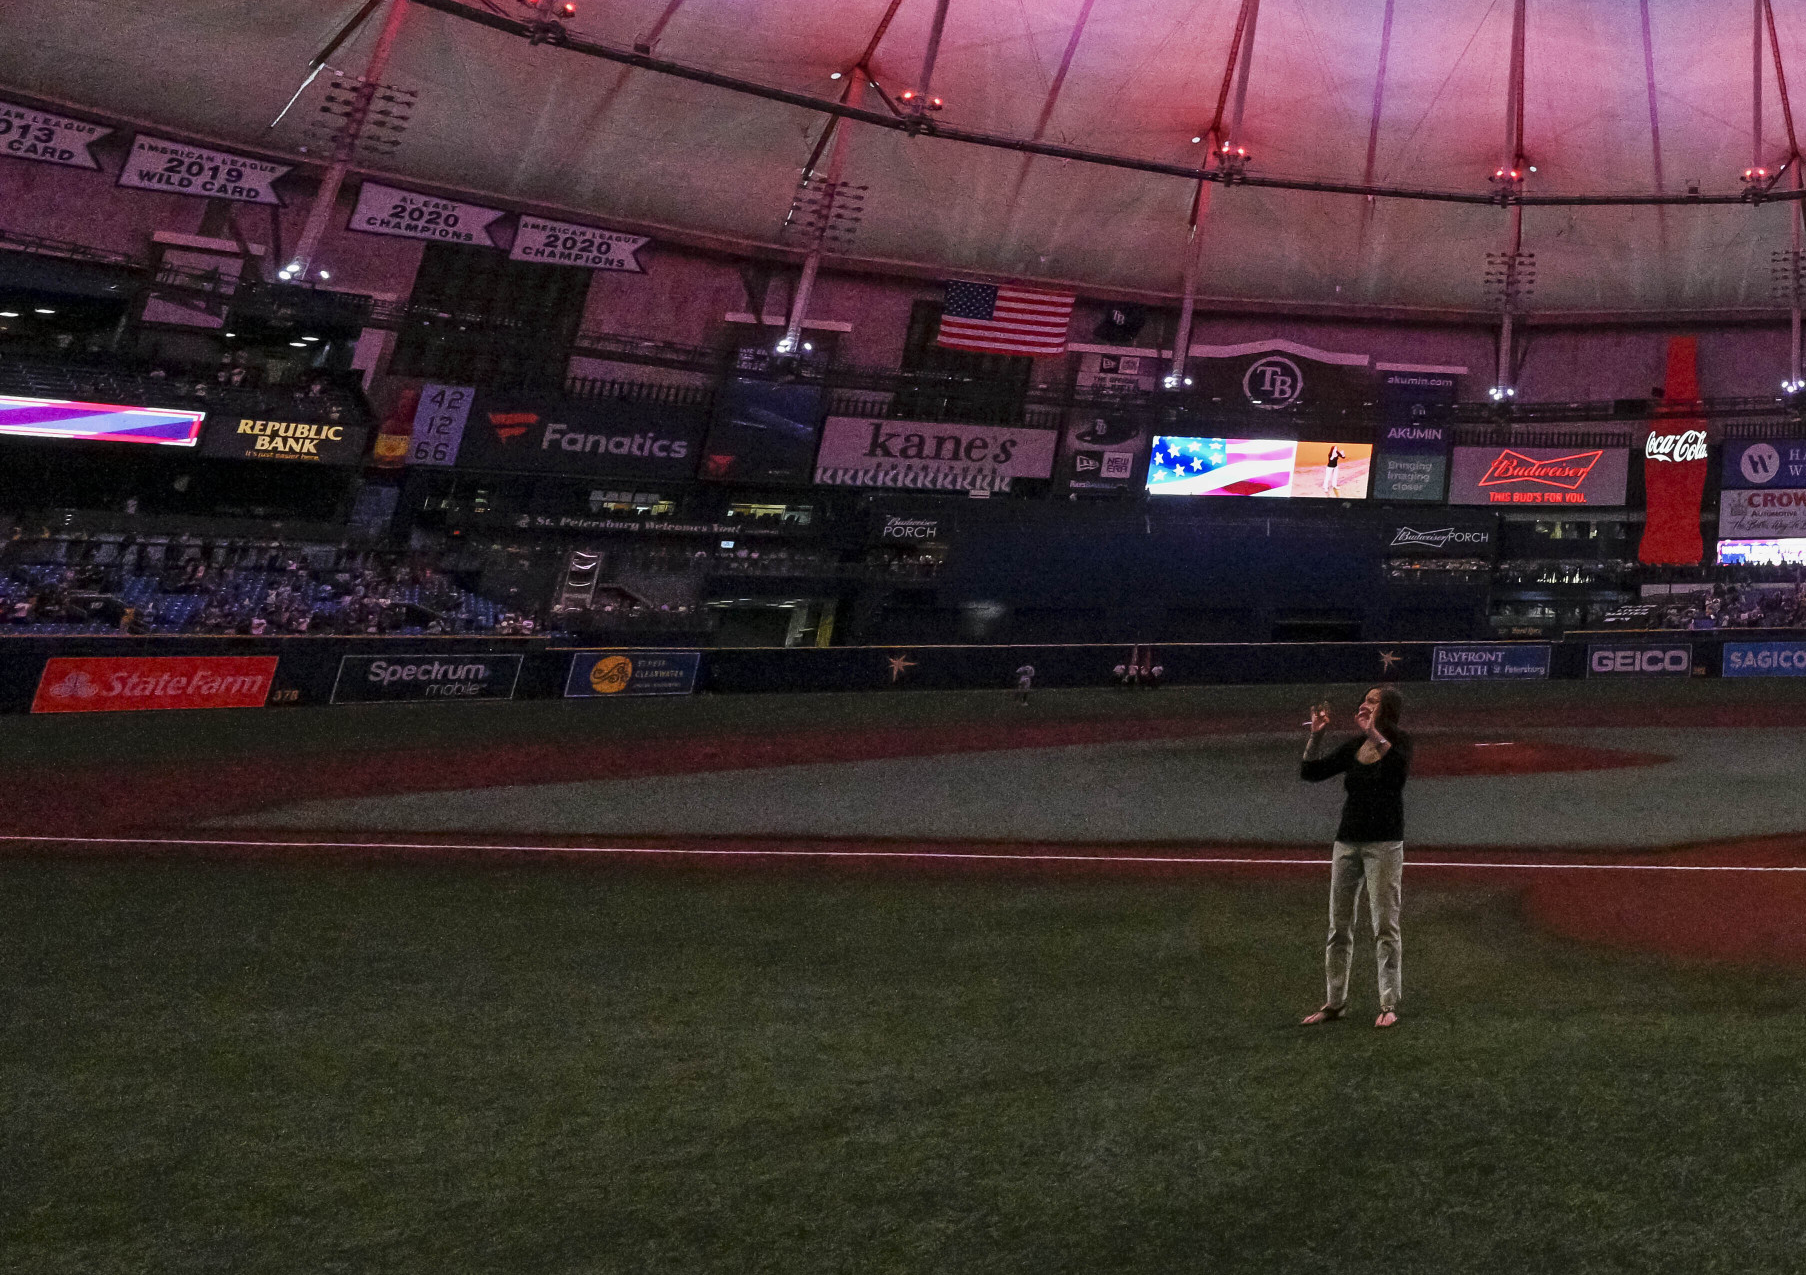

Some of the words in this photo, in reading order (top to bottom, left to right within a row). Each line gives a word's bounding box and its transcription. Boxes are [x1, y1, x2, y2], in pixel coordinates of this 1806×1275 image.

[32, 115, 97, 136] LEAGUE
[7, 139, 75, 162] CARD
[138, 142, 215, 163] AMERICAN
[221, 158, 278, 174] LEAGUE
[163, 156, 244, 184] 2019
[137, 169, 193, 189] WILD
[201, 180, 260, 200] CARD
[389, 204, 460, 228] 2020
[422, 199, 459, 213] EAST
[366, 216, 474, 242] CHAMPIONS
[521, 222, 587, 238] AMERICAN
[543, 234, 612, 256] 2020
[521, 246, 626, 269] CHAMPIONS
[1387, 376, 1453, 387] akumin.com
[430, 389, 466, 411] 42
[237, 419, 344, 441] REPUBLIC
[426, 416, 453, 435] 12
[1387, 428, 1443, 440] AKUMIN
[254, 436, 320, 454] BANK
[414, 441, 450, 461] 66
[541, 423, 688, 459] Fanatics
[863, 422, 1018, 464] kane's
[1106, 456, 1131, 467] NEW
[1491, 458, 1590, 479] Budweiser
[1489, 491, 1511, 503] THIS
[1544, 492, 1563, 503] FOR
[882, 525, 937, 539] PORCH
[1396, 528, 1449, 543] Budweiser
[1448, 532, 1490, 544] PORCH
[1437, 649, 1504, 664] BAYFRONT
[1591, 649, 1690, 673] GEICO
[368, 660, 486, 686] Spectrum
[1437, 663, 1489, 677] HEALTH
[425, 681, 480, 697] mobile
